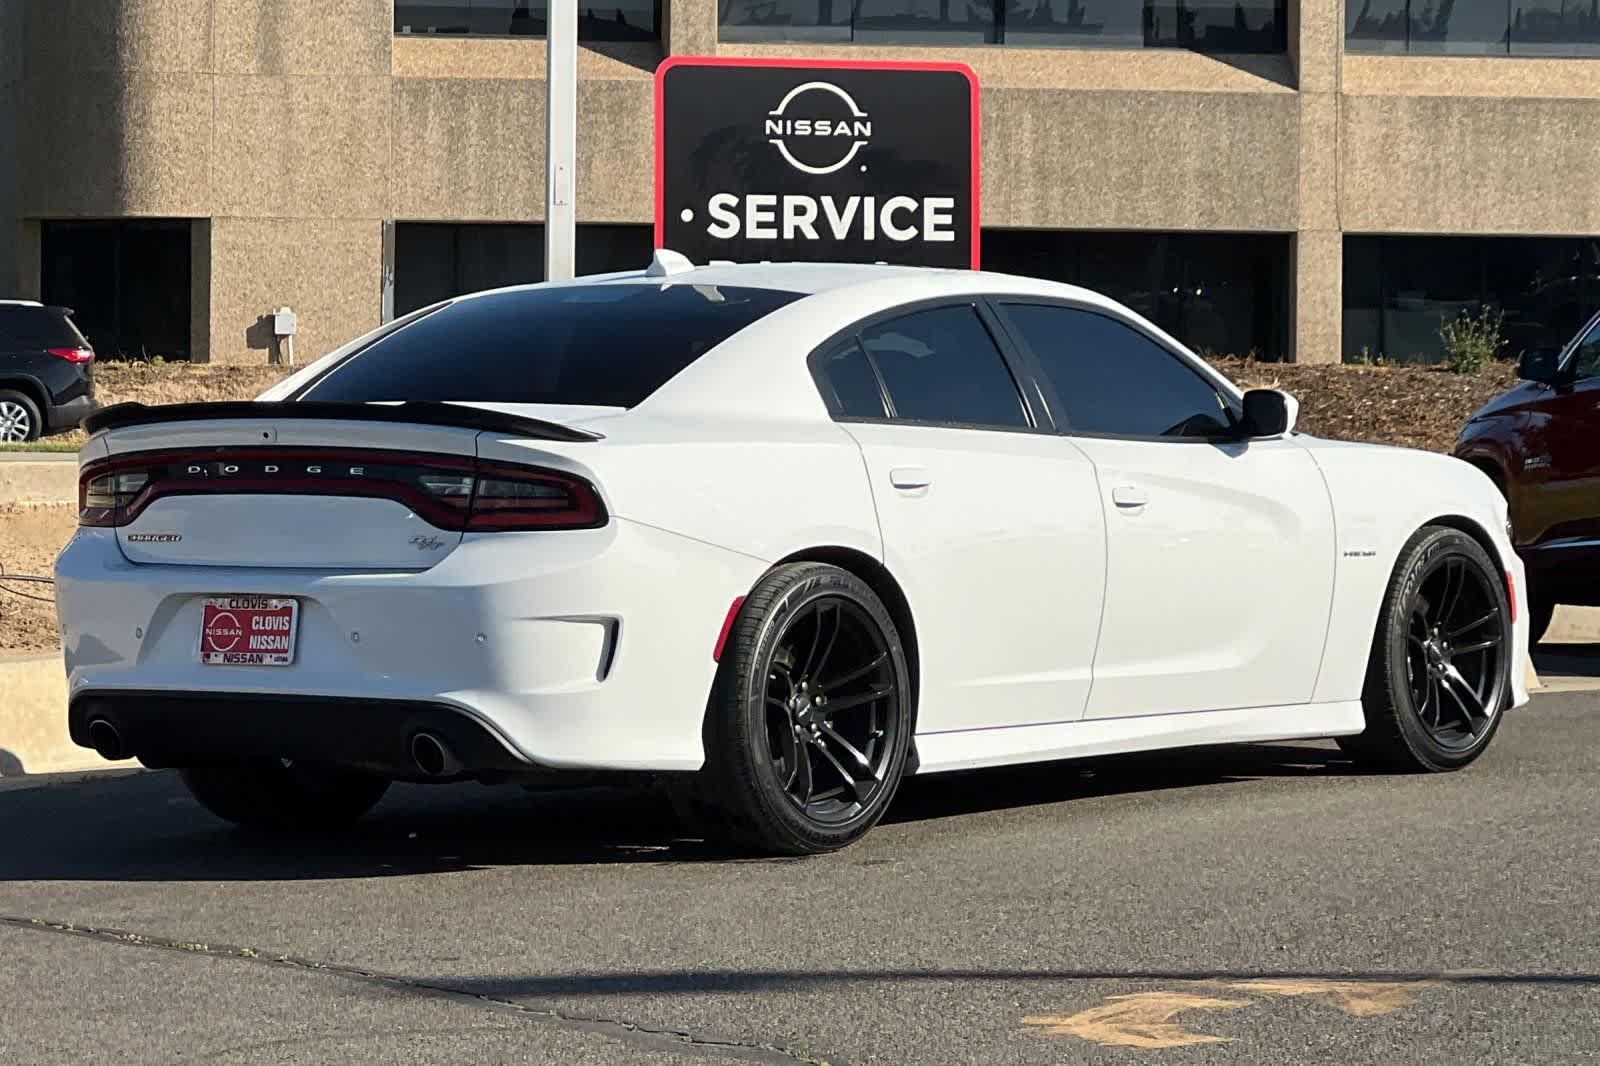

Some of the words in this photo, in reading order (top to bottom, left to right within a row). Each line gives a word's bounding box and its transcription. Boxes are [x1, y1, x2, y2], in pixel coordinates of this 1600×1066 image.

[765, 119, 872, 137] NISSAN
[706, 193, 955, 242] SERVICE
[187, 464, 364, 476] DODGE
[229, 599, 269, 609] CLOVIS
[251, 615, 290, 631] CLOVIS
[205, 628, 242, 637] NISSAN
[249, 635, 289, 650] NISSAN
[223, 653, 264, 664] NISSAN
